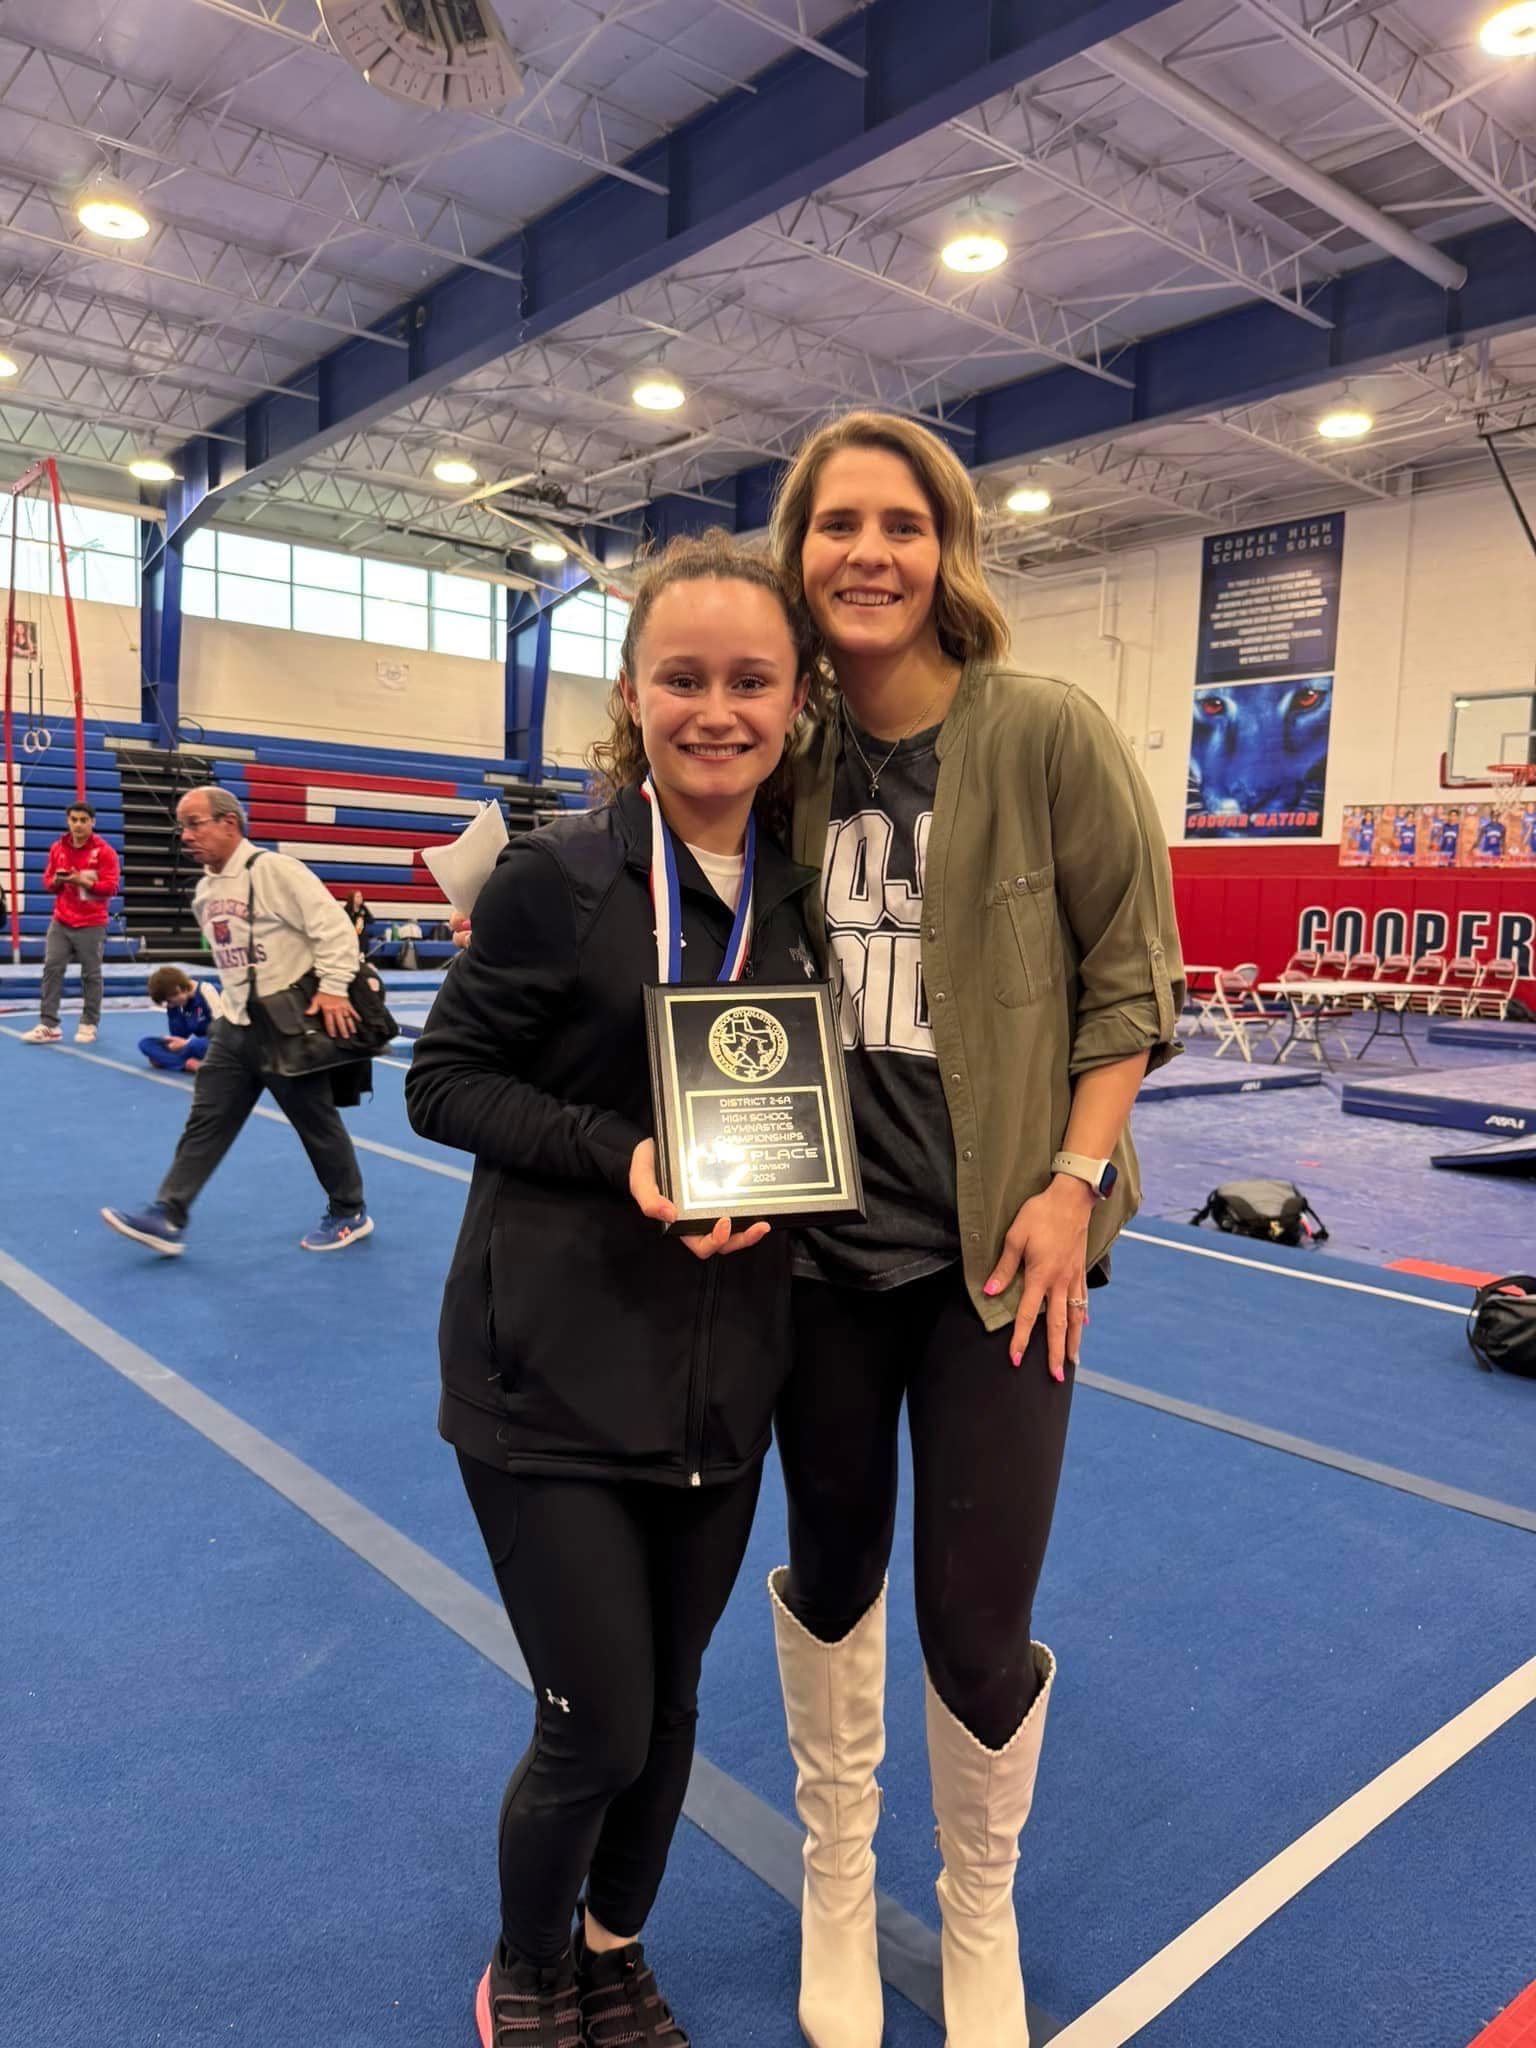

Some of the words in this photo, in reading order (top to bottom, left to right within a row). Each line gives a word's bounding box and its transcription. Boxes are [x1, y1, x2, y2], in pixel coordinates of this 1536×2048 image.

[1213, 532, 1278, 553] COOPER
[1288, 522, 1332, 540] HIGH
[1211, 545, 1276, 565] SCHOOL
[1286, 535, 1333, 553] SONG
[1253, 811, 1320, 828] NATION
[1297, 905, 1536, 981] COOPER
[720, 1097, 767, 1107] DISTRICT
[769, 1096, 792, 1105] 2-6A
[722, 1113, 748, 1123] HIGH
[750, 1112, 793, 1121] SCHOOL
[723, 1122, 794, 1134] GYMNASTICS
[715, 1132, 804, 1144] CMPIONSHIPS
[750, 1147, 818, 1160] PLACE
[752, 1173, 776, 1183] 2025
